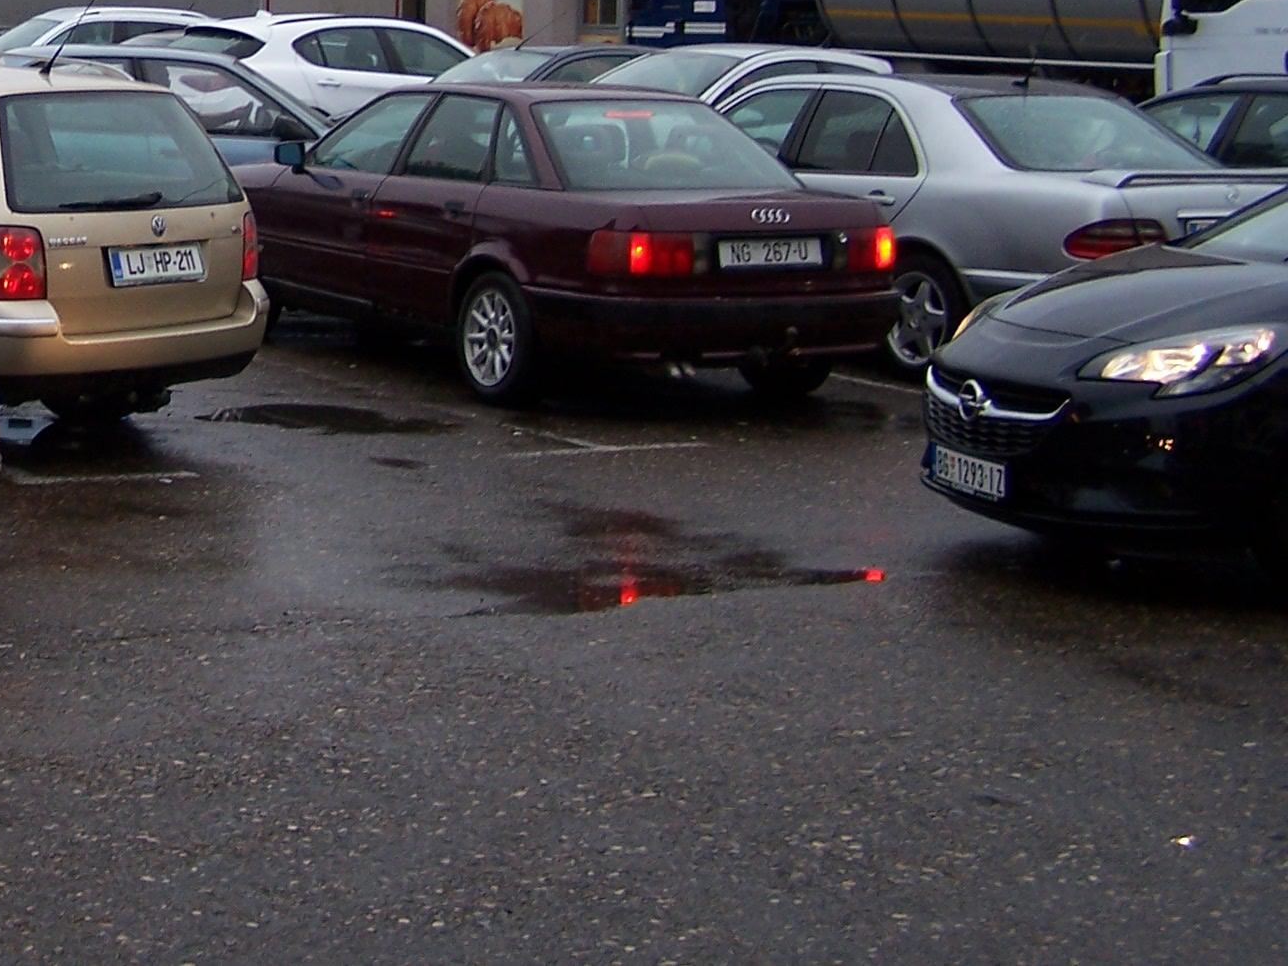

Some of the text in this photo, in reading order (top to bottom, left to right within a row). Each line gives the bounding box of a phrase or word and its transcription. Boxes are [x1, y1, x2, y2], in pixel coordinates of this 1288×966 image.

[126, 250, 196, 275] LJ HP-211
[731, 242, 808, 263] NG 267-U
